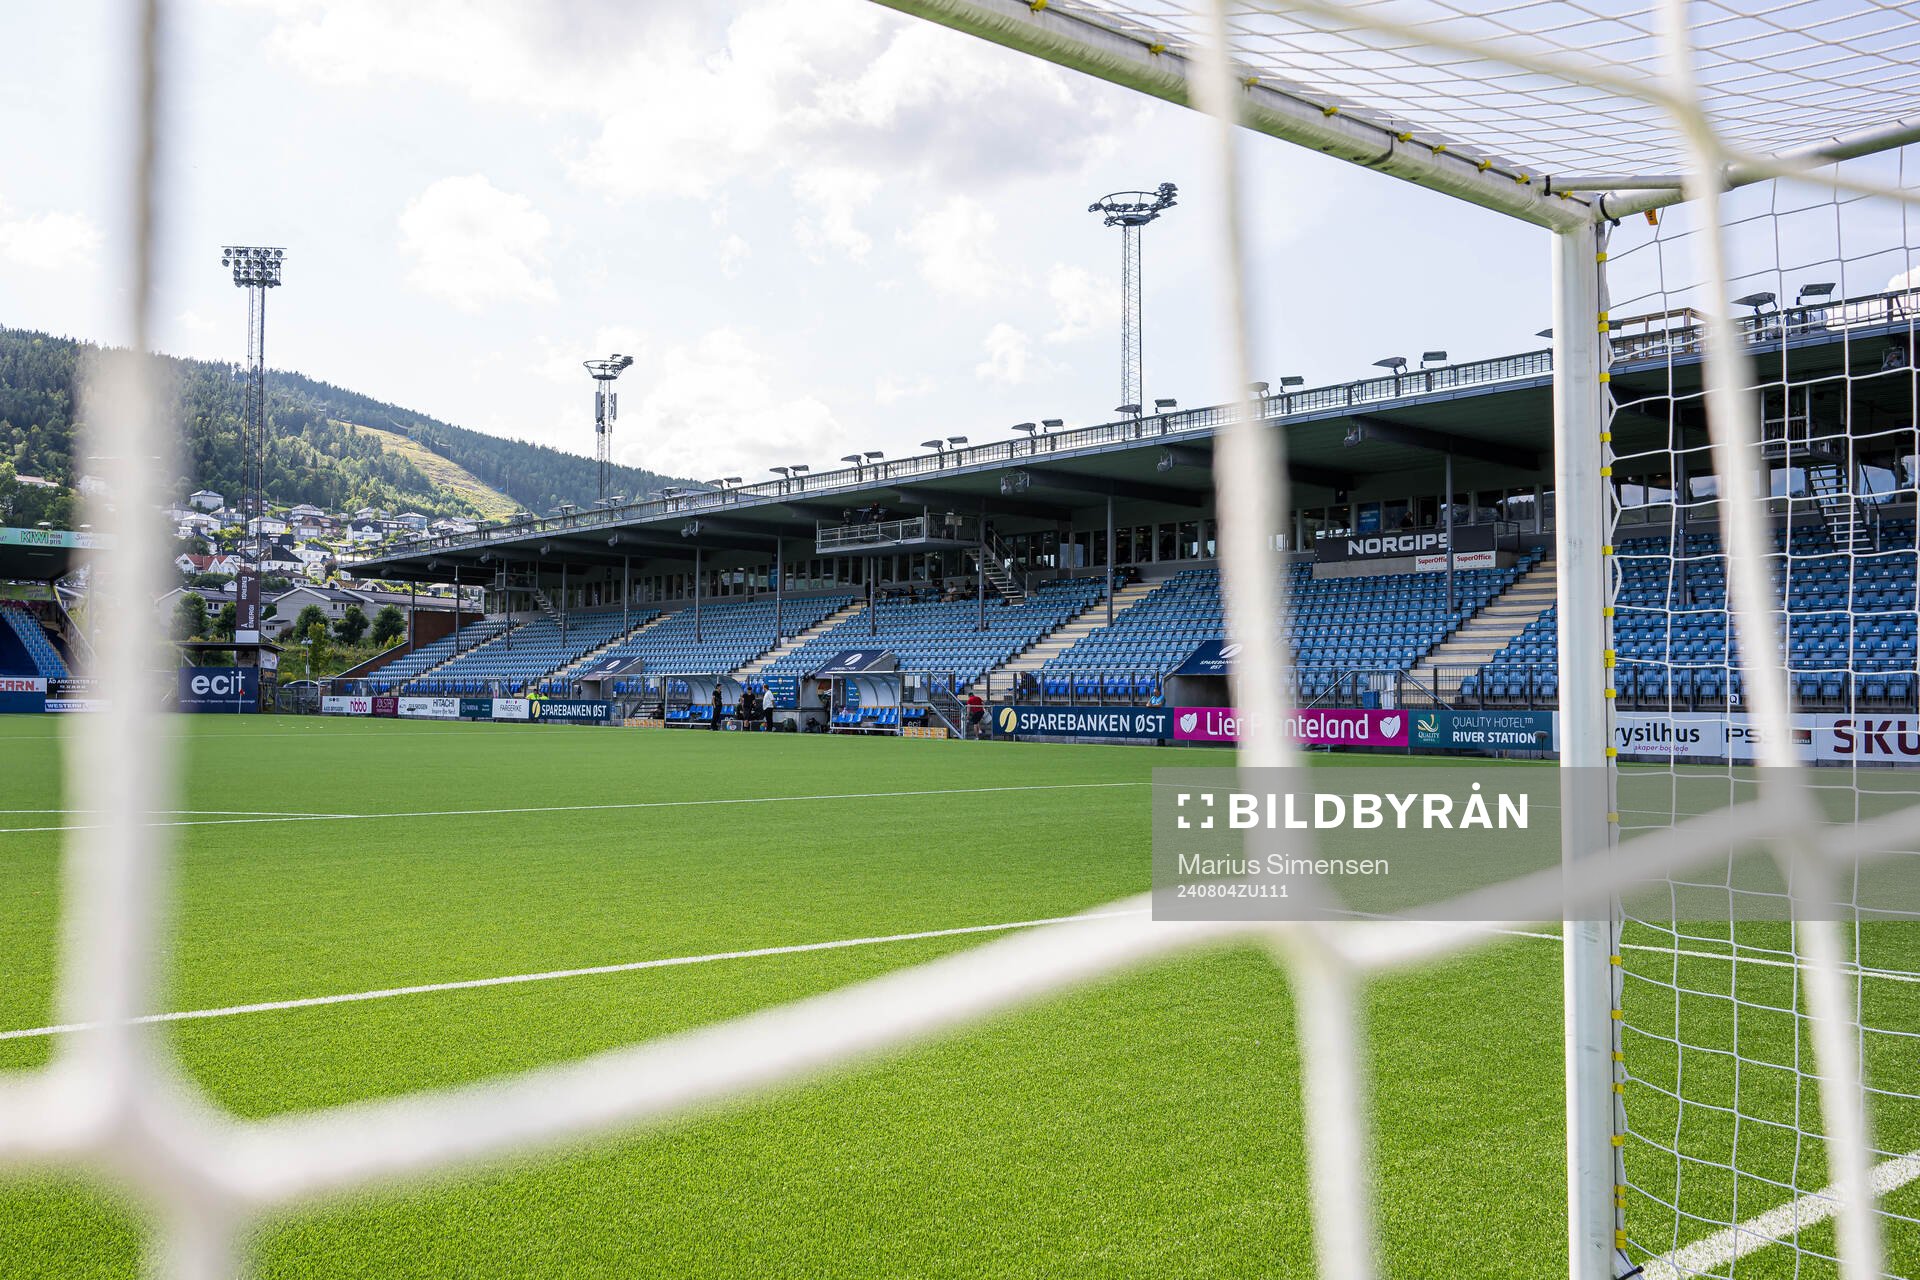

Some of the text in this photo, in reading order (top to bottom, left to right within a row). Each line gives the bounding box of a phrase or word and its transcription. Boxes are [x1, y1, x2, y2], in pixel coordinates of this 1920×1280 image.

[20, 531, 49, 544] KIWI
[1347, 533, 1448, 555] NORGIPS
[1418, 556, 1448, 565] SuperOffic
[1457, 554, 1492, 563] SuperOffice
[191, 670, 246, 695] ecit
[432, 699, 455, 708] HITACHI
[541, 704, 607, 717] SPAREBANKEN ØST
[1020, 713, 1166, 734] SPAREBANKEN ØST
[1206, 711, 1244, 736] Lier
[1452, 716, 1492, 728] QUALITY
[1453, 731, 1537, 744] RIVER STATION
[1615, 722, 1700, 747] rysilhus
